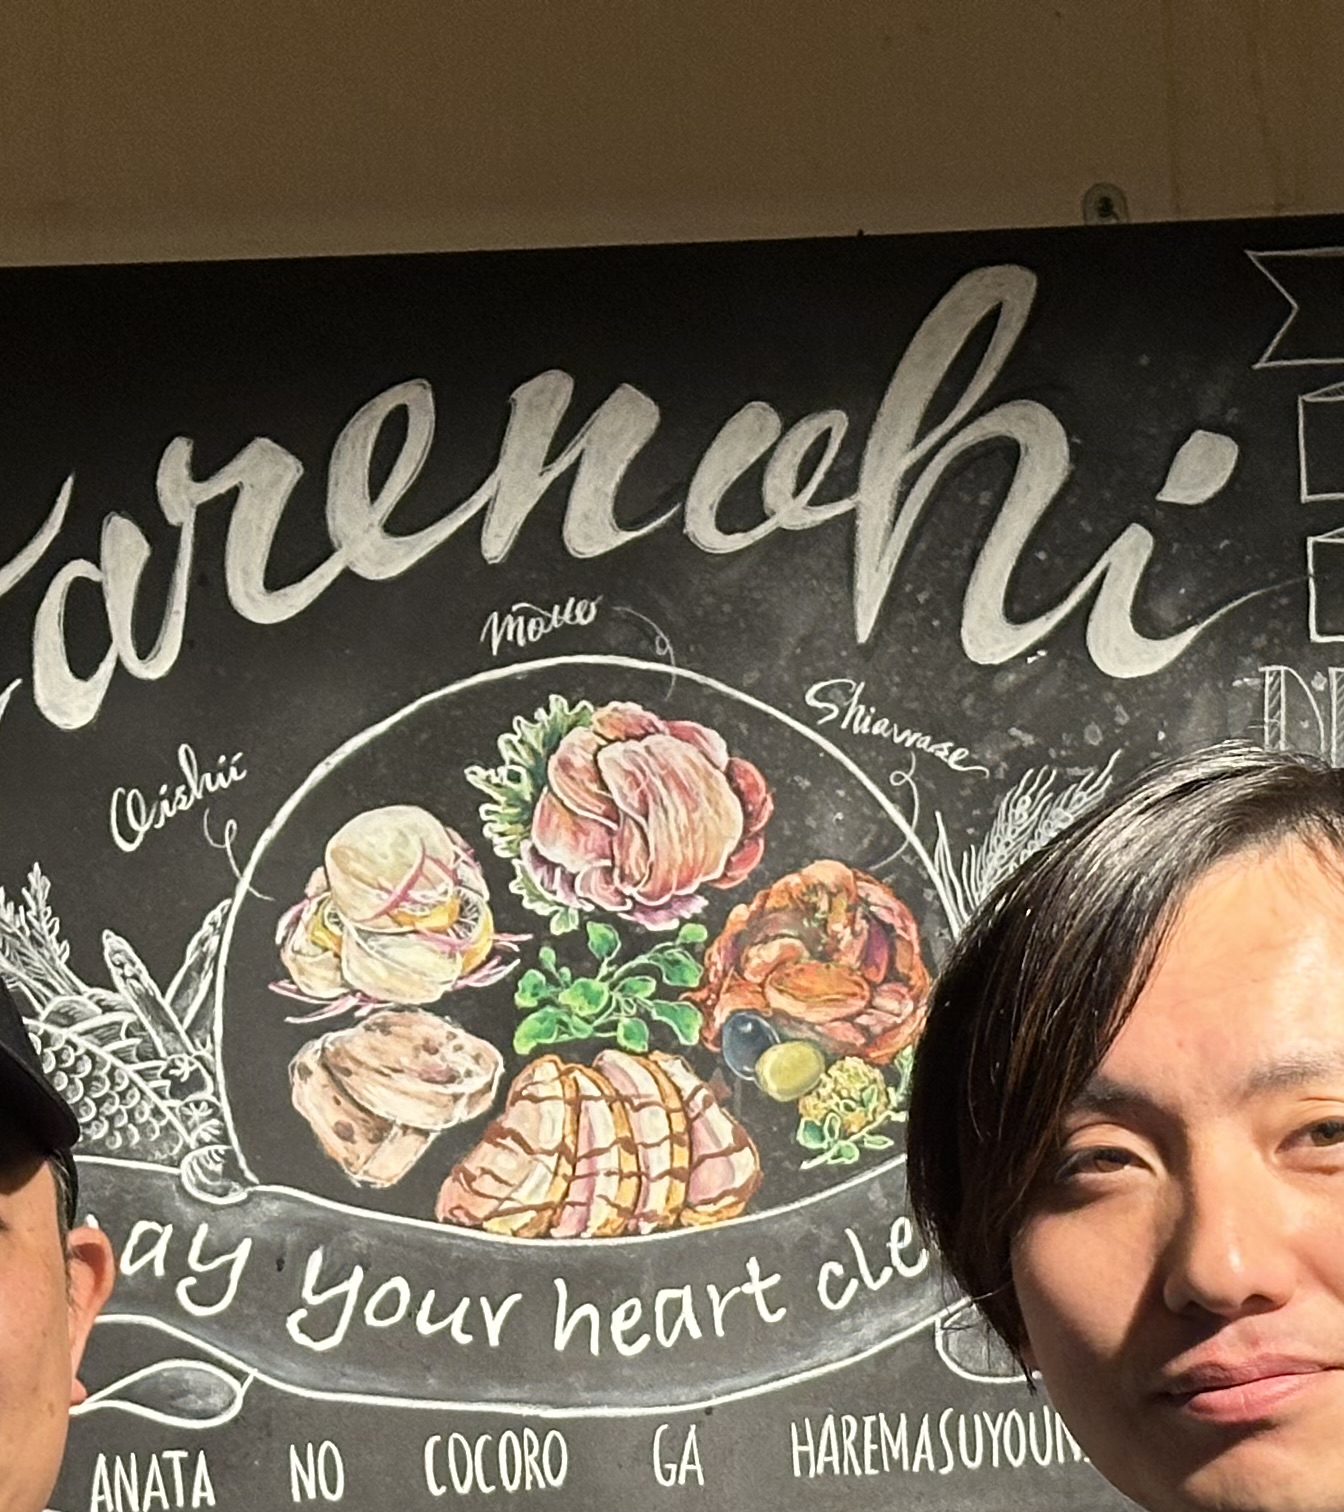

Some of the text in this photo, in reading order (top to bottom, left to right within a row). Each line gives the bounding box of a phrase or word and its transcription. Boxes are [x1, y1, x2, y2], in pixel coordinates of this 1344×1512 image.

[110, 743, 248, 852] Oishii
[86, 1214, 931, 1357] ay your heart cle
[289, 1439, 345, 1503] NO
[424, 1427, 569, 1498] COCORO
[653, 1424, 705, 1488] GA
[790, 1405, 1090, 1479] HAREMASUYOUN
